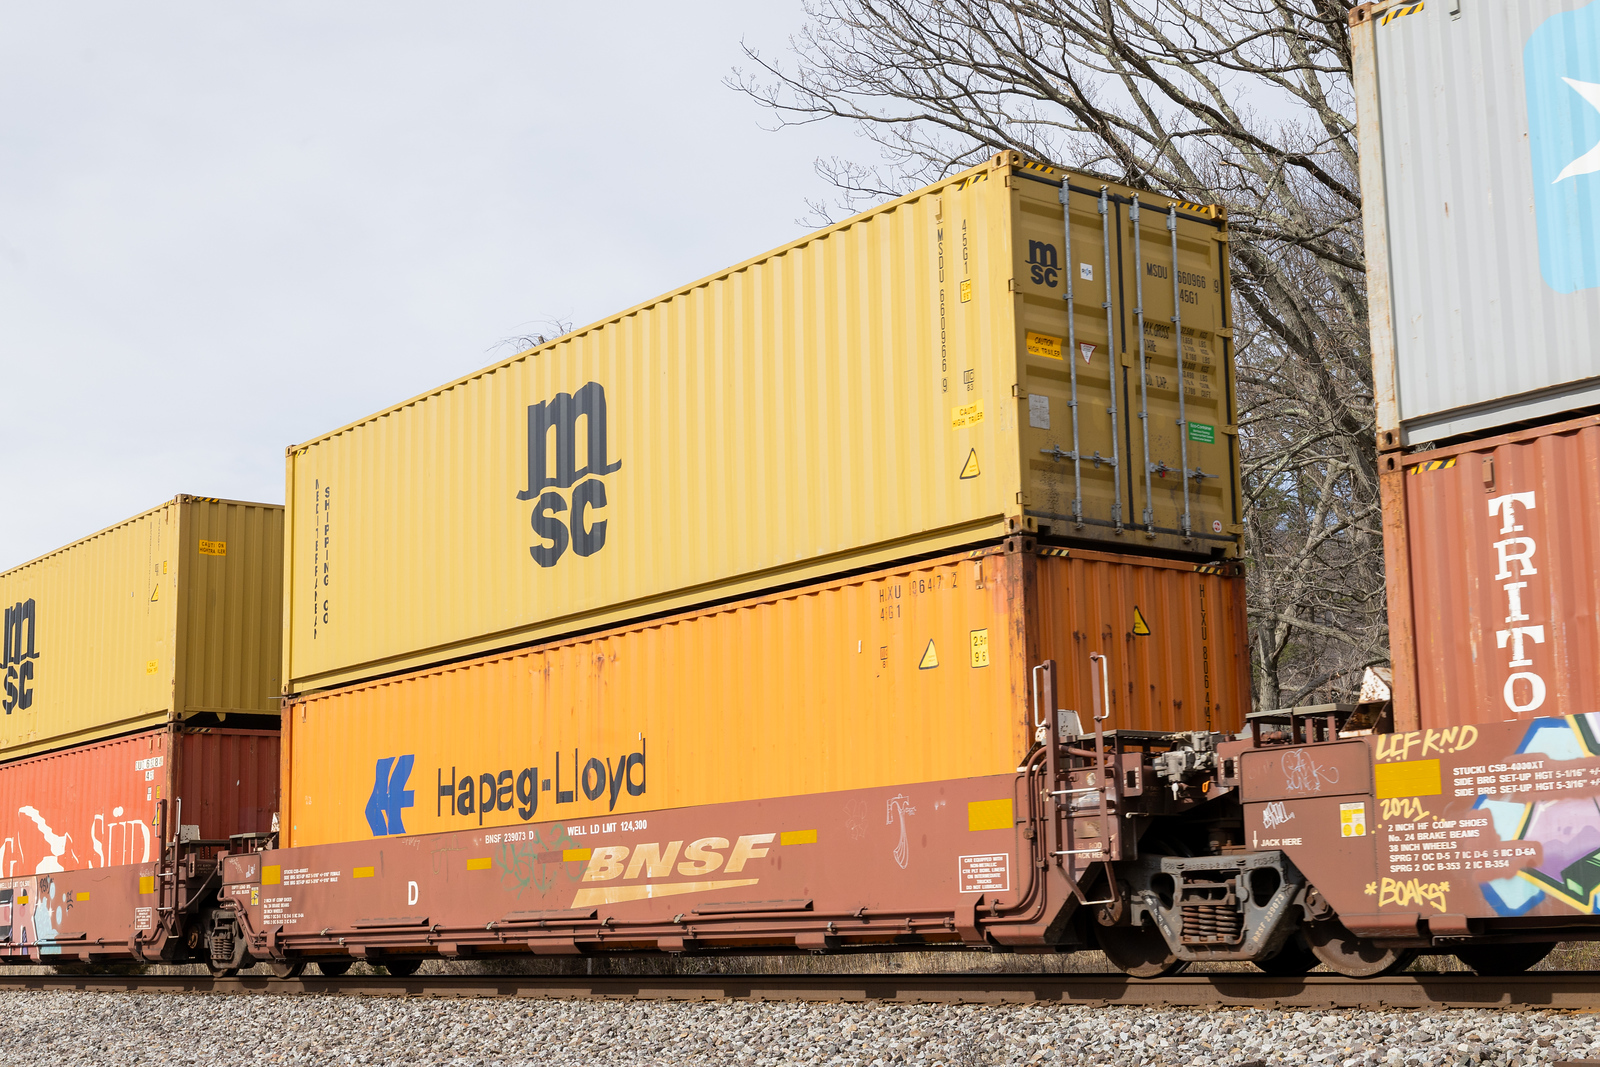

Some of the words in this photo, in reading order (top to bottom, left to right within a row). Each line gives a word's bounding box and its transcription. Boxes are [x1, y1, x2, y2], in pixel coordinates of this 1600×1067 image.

[937, 228, 945, 283] MSDU
[1146, 262, 1168, 279] MSDU
[1178, 271, 1206, 289] 660966
[1214, 279, 1220, 293] 9
[1180, 289, 1198, 305] 45G1
[1034, 336, 1055, 347] CAUTION
[323, 486, 331, 586] SHIPPING
[323, 600, 329, 624] CO
[1199, 584, 1207, 641] HLXU
[1488, 490, 1551, 722] TRITO
[1453, 765, 1486, 776] STUCKI
[1454, 777, 1474, 786] SIDE
[1477, 776, 1496, 785] BRG
[1499, 773, 1531, 783] SET-UP
[1535, 771, 1553, 780] HGT
[437, 737, 647, 826] Hapag-Lloyd
[1454, 788, 1474, 797] SIDE
[1477, 786, 1497, 795] BRG
[1500, 783, 1532, 794] SET-UP
[1535, 781, 1554, 791] HGT
[1380, 797, 1430, 822] 2021
[567, 825, 587, 836] WELL
[590, 824, 600, 835] LD
[602, 822, 617, 833] LMT
[620, 819, 647, 832] 124,300
[1388, 824, 1393, 832] 2
[1395, 823, 1414, 831] INCH
[1417, 822, 1429, 830] HF
[1432, 820, 1456, 829] COMP
[1459, 819, 1488, 828] SHOES
[485, 834, 502, 844] BNSF
[504, 831, 525, 842] 239073
[528, 830, 534, 840] D
[1261, 838, 1280, 847] JACK
[1282, 838, 1302, 846] HERE
[1404, 833, 1415, 841] 24
[1417, 831, 1446, 840] BRAKE
[1449, 829, 1480, 839] BEAMS
[1389, 854, 1412, 862] SPRG
[1414, 853, 1419, 861] 7
[1436, 852, 1450, 860] D-5
[1455, 851, 1460, 859] 7
[1462, 851, 1471, 859] IC
[1474, 850, 1488, 858] D-6
[1515, 847, 1536, 856] D-6A
[1401, 843, 1420, 852] INCH
[1422, 841, 1457, 850] WHEELS
[581, 832, 777, 883] BNSF
[1390, 864, 1412, 872] SPRG
[1415, 864, 1420, 872] 2
[1422, 863, 1435, 871] OC
[1437, 862, 1460, 871] B-353
[1465, 861, 1471, 869] 2
[1473, 861, 1482, 869] IC
[1485, 859, 1509, 869] B-354
[408, 881, 419, 906] D
[1264, 893, 1285, 922] 239073
